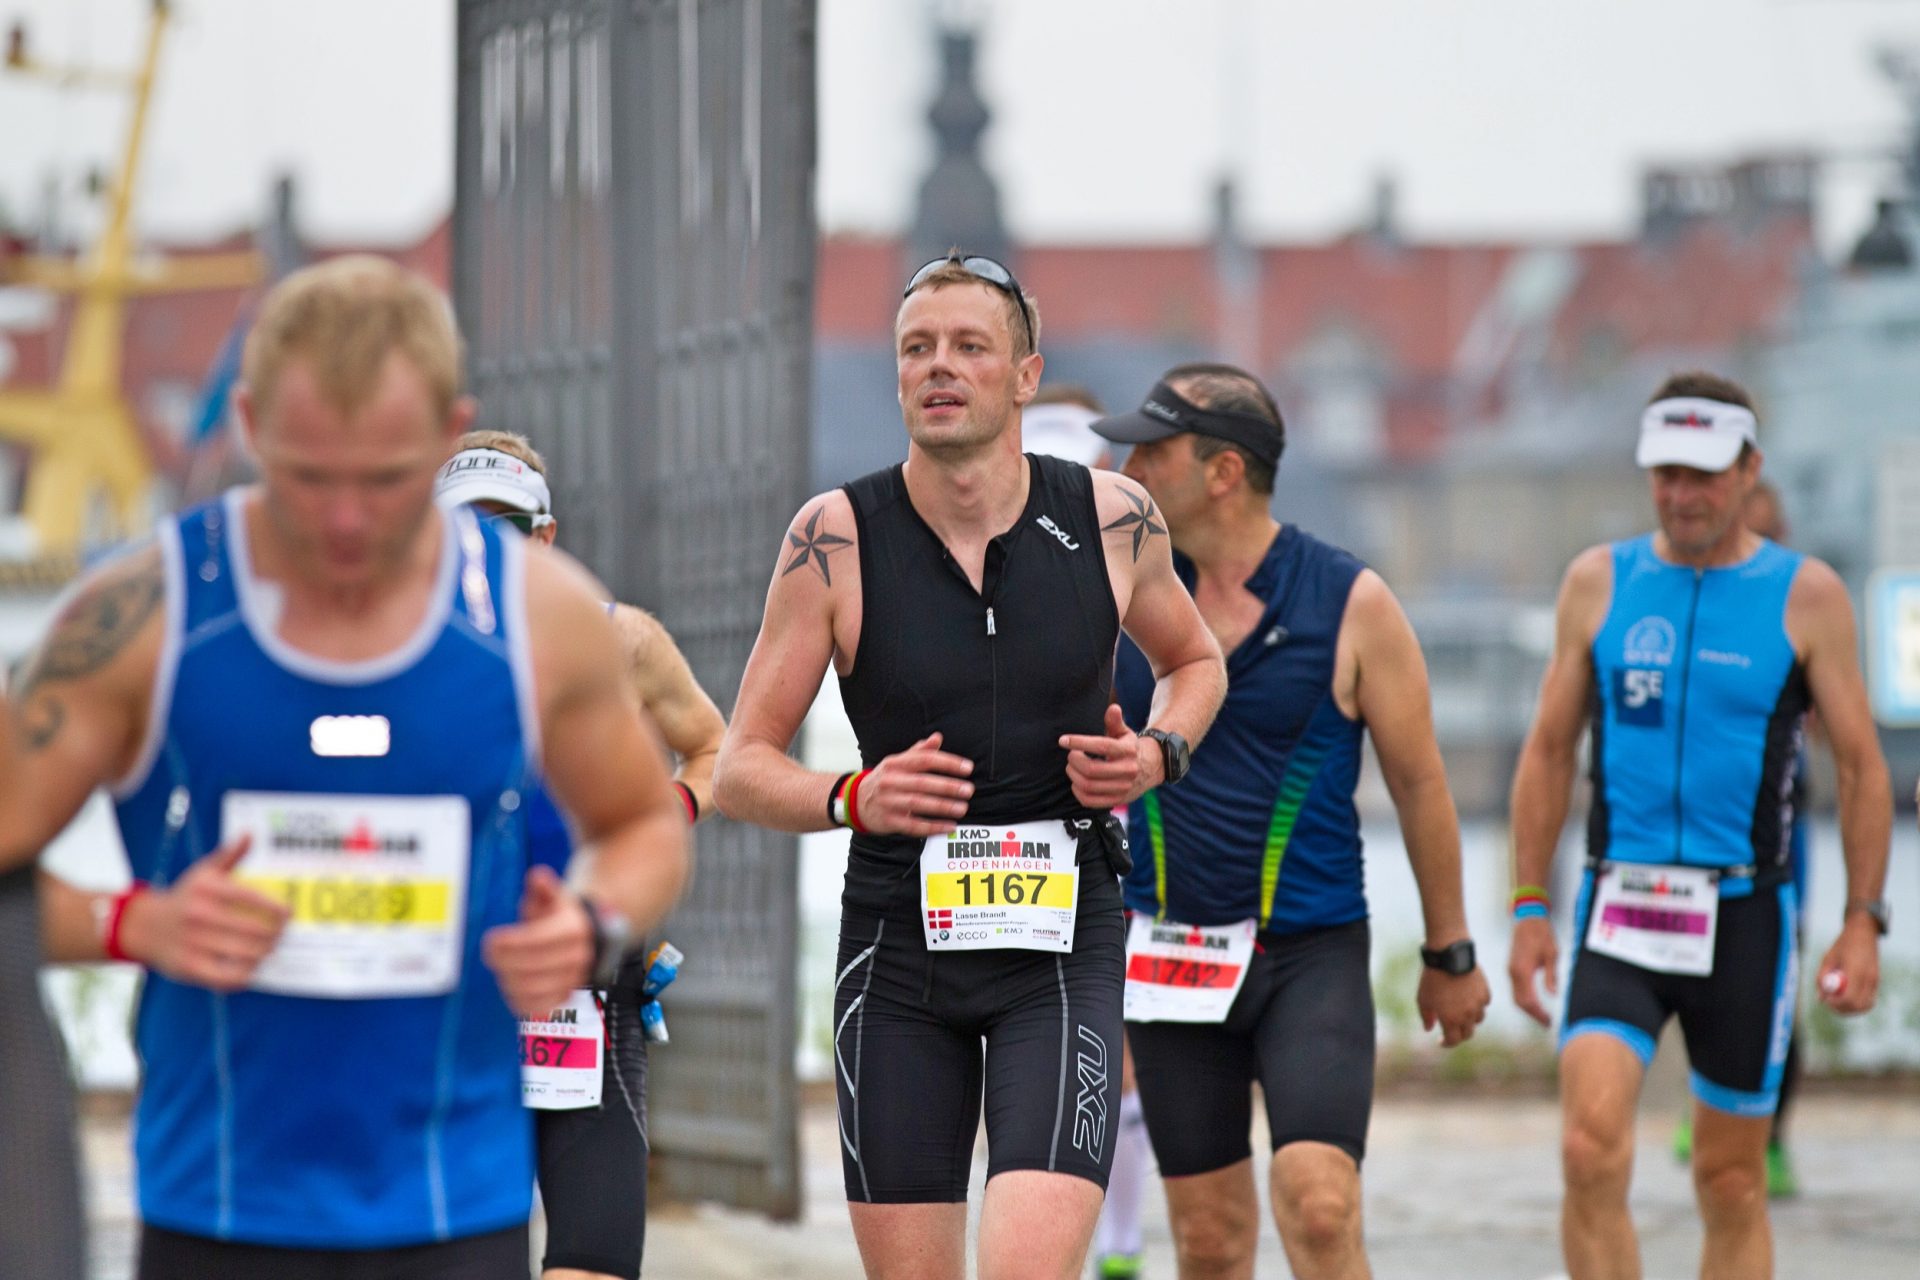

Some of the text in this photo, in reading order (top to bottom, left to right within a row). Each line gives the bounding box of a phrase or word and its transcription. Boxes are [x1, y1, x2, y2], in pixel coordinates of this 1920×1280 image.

[1036, 515, 1079, 550] 2XU
[947, 833, 1051, 859] IRONMAN
[960, 829, 990, 839] KMD
[947, 860, 1052, 870] COPENHAGEN
[956, 873, 1048, 905] 1167
[980, 911, 1007, 919] Brandt
[1151, 957, 1222, 988] 1742
[1072, 1024, 1108, 1165] 2XU
